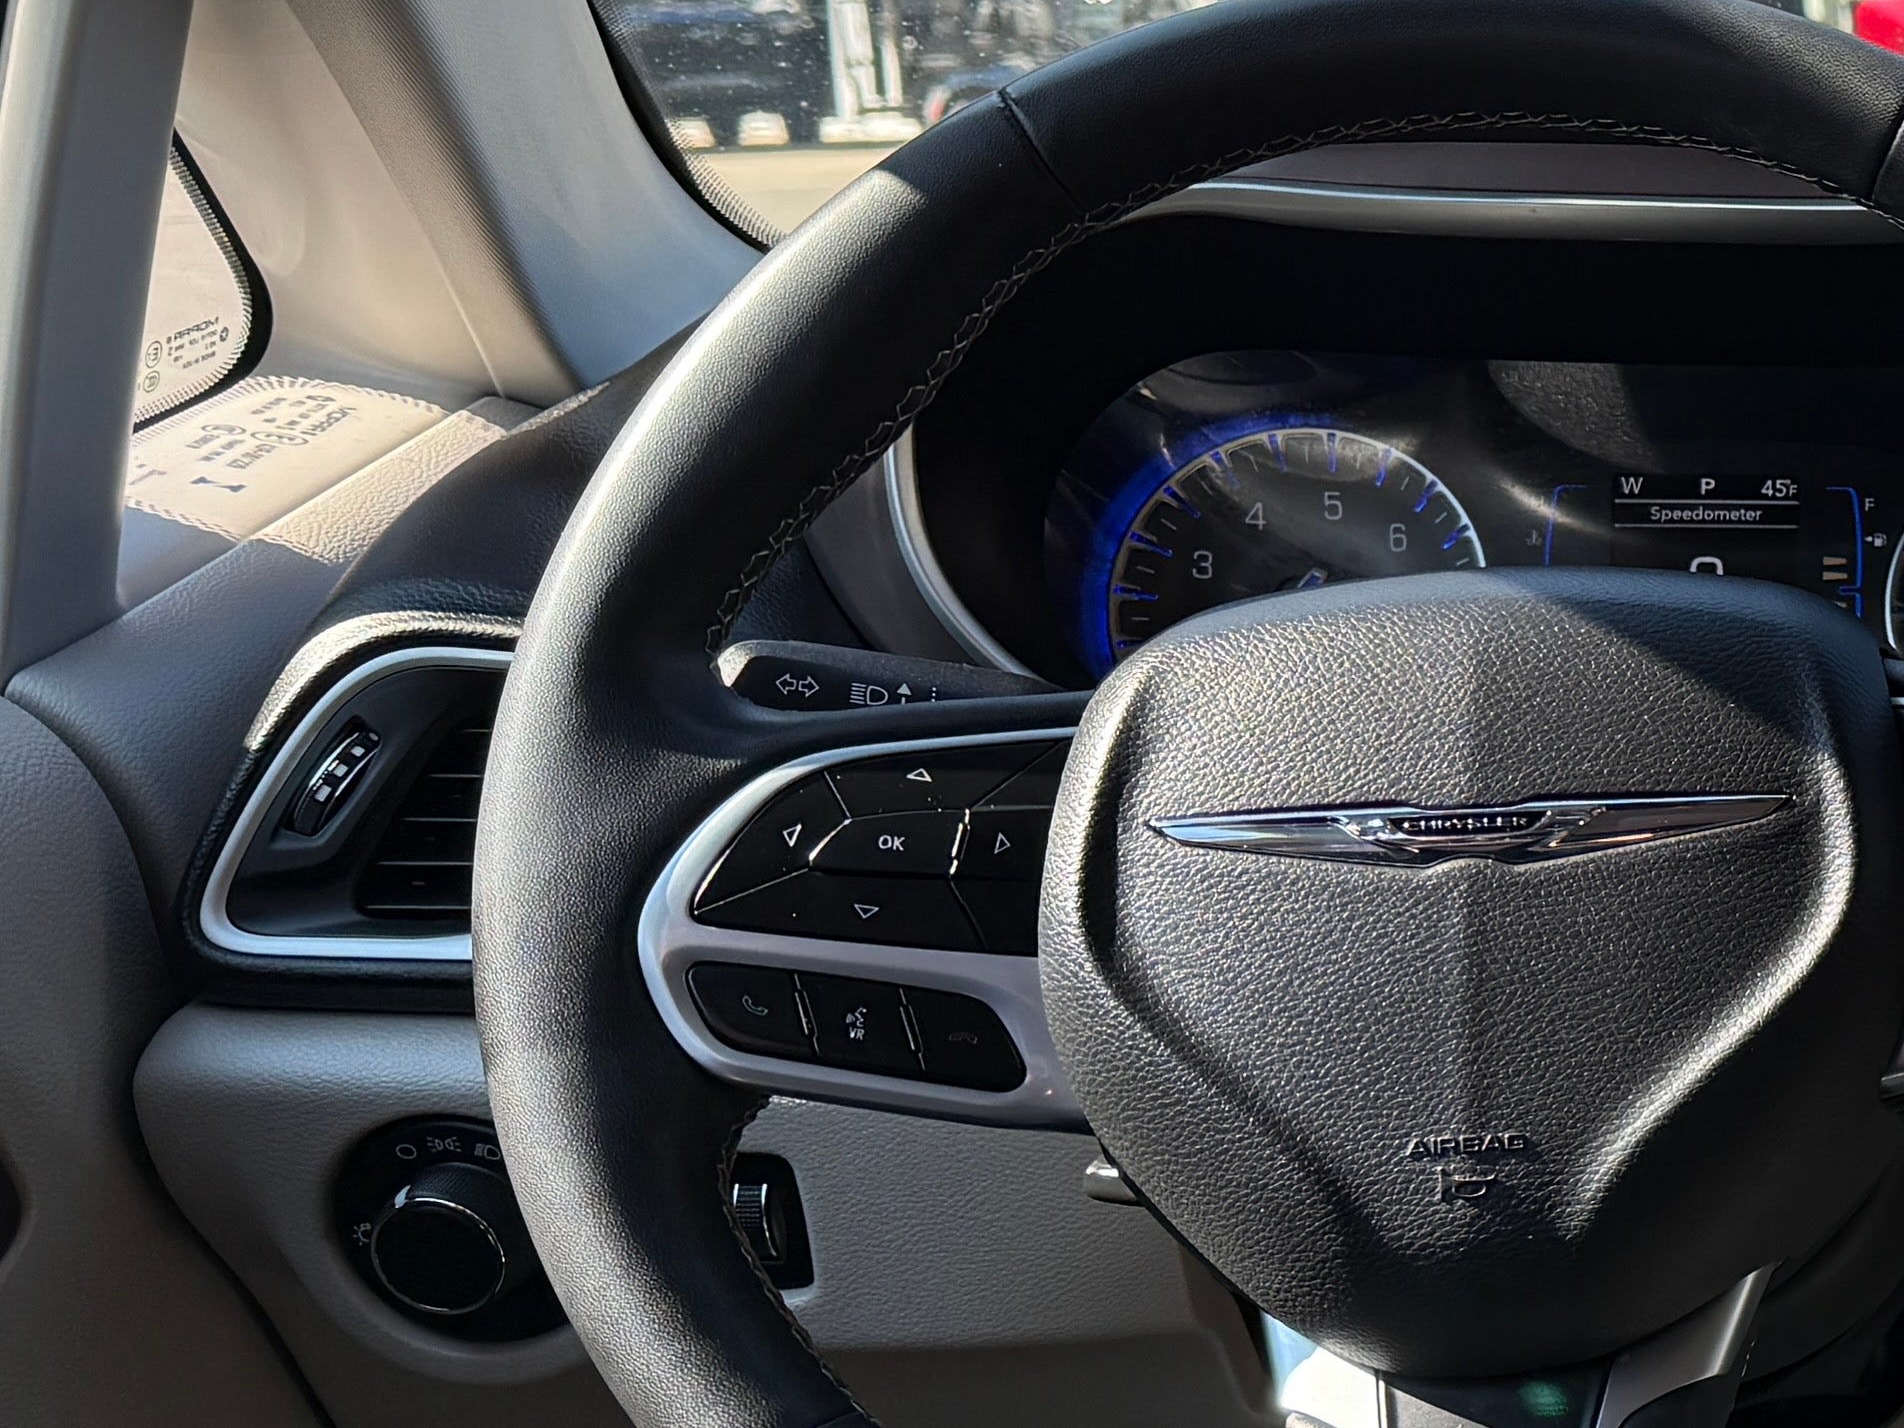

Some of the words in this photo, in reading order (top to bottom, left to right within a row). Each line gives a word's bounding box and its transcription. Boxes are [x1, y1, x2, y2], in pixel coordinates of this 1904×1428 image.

[1620, 476, 1644, 494] W
[1700, 478, 1716, 495] P
[1244, 501, 1267, 531] 4
[1323, 490, 1344, 521] 5
[1650, 506, 1763, 523] Speedometer
[1864, 498, 1876, 514] F
[1389, 522, 1408, 552] 6
[1192, 550, 1213, 580] 3
[878, 834, 906, 852] OK
[848, 1026, 865, 1042] VR
[1404, 1132, 1529, 1158] AIRBAG
